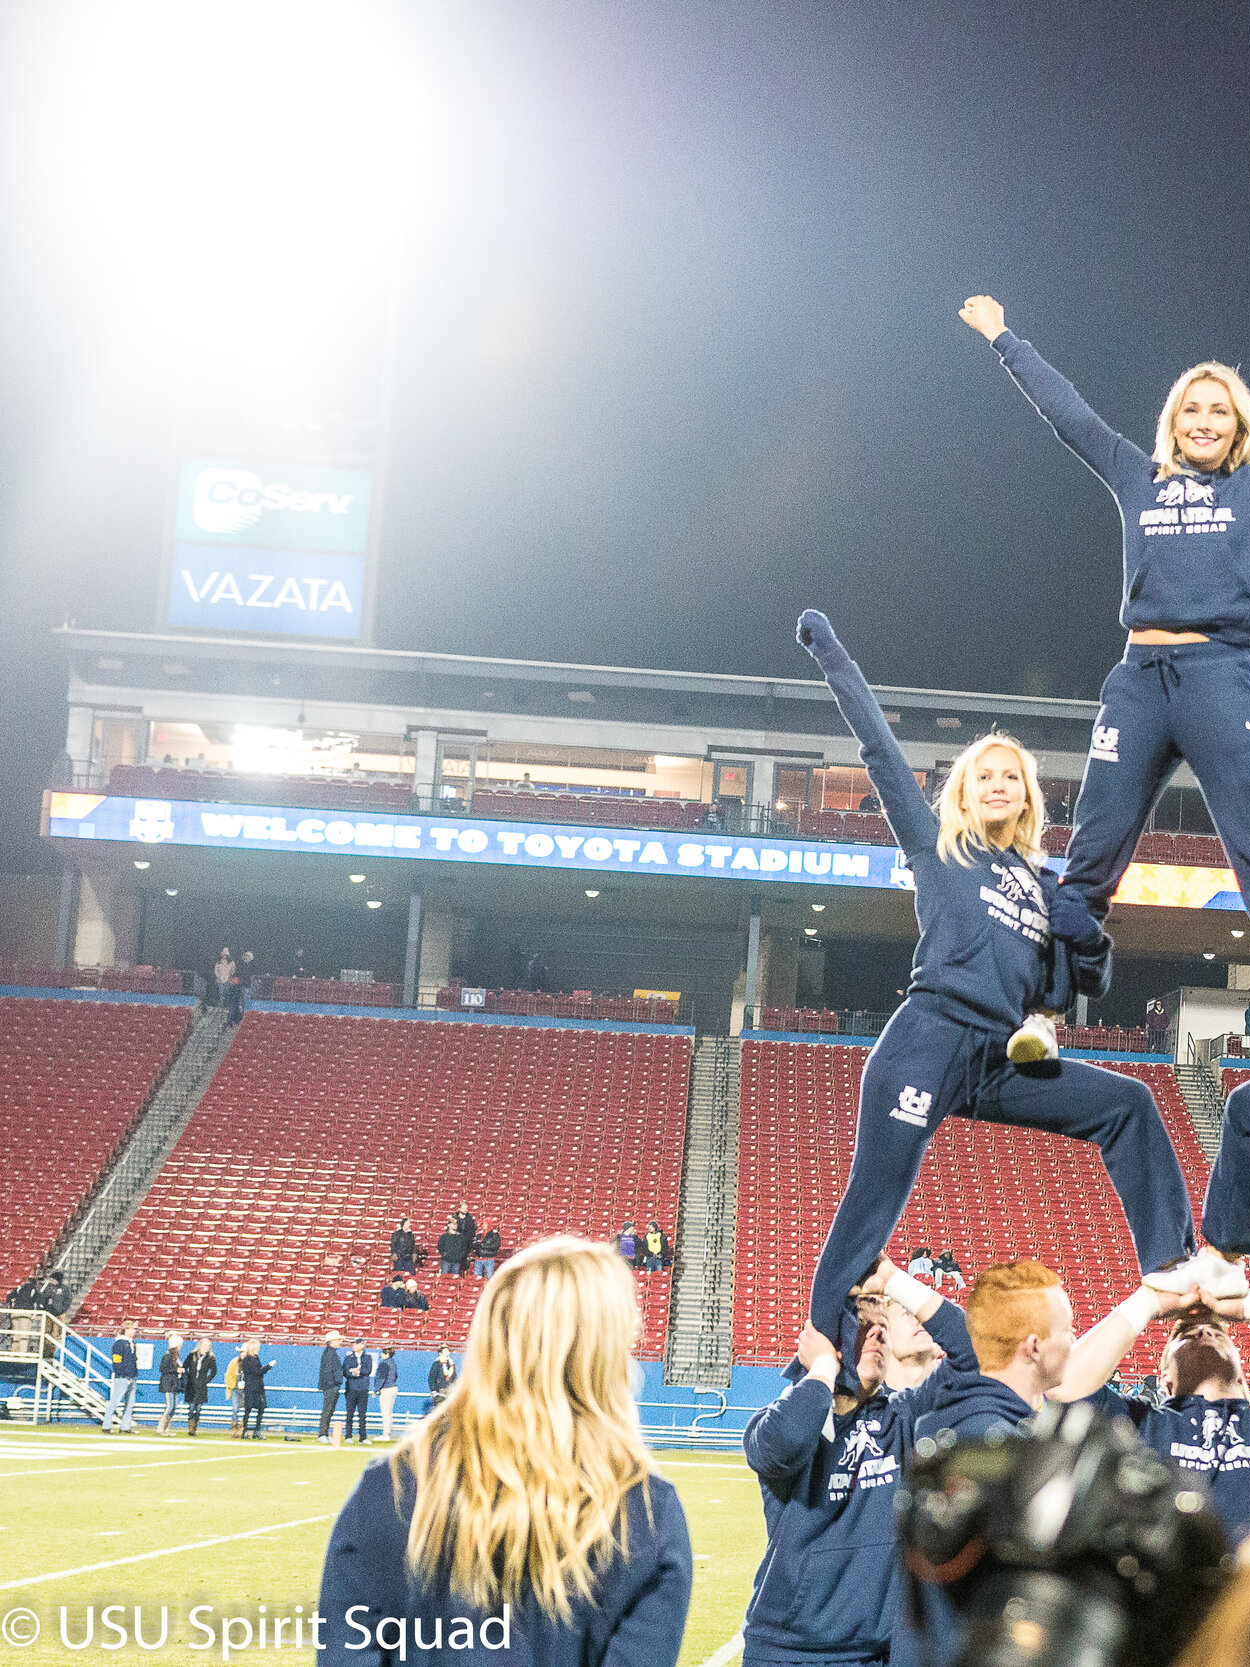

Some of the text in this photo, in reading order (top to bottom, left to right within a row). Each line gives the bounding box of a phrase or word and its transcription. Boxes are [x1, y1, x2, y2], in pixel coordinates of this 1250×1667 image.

[208, 480, 354, 514] CoServ
[180, 568, 354, 613] VAZATA
[201, 812, 869, 877] WELCOME TO TOYOTA STADIUM
[464, 994, 483, 1006] 110
